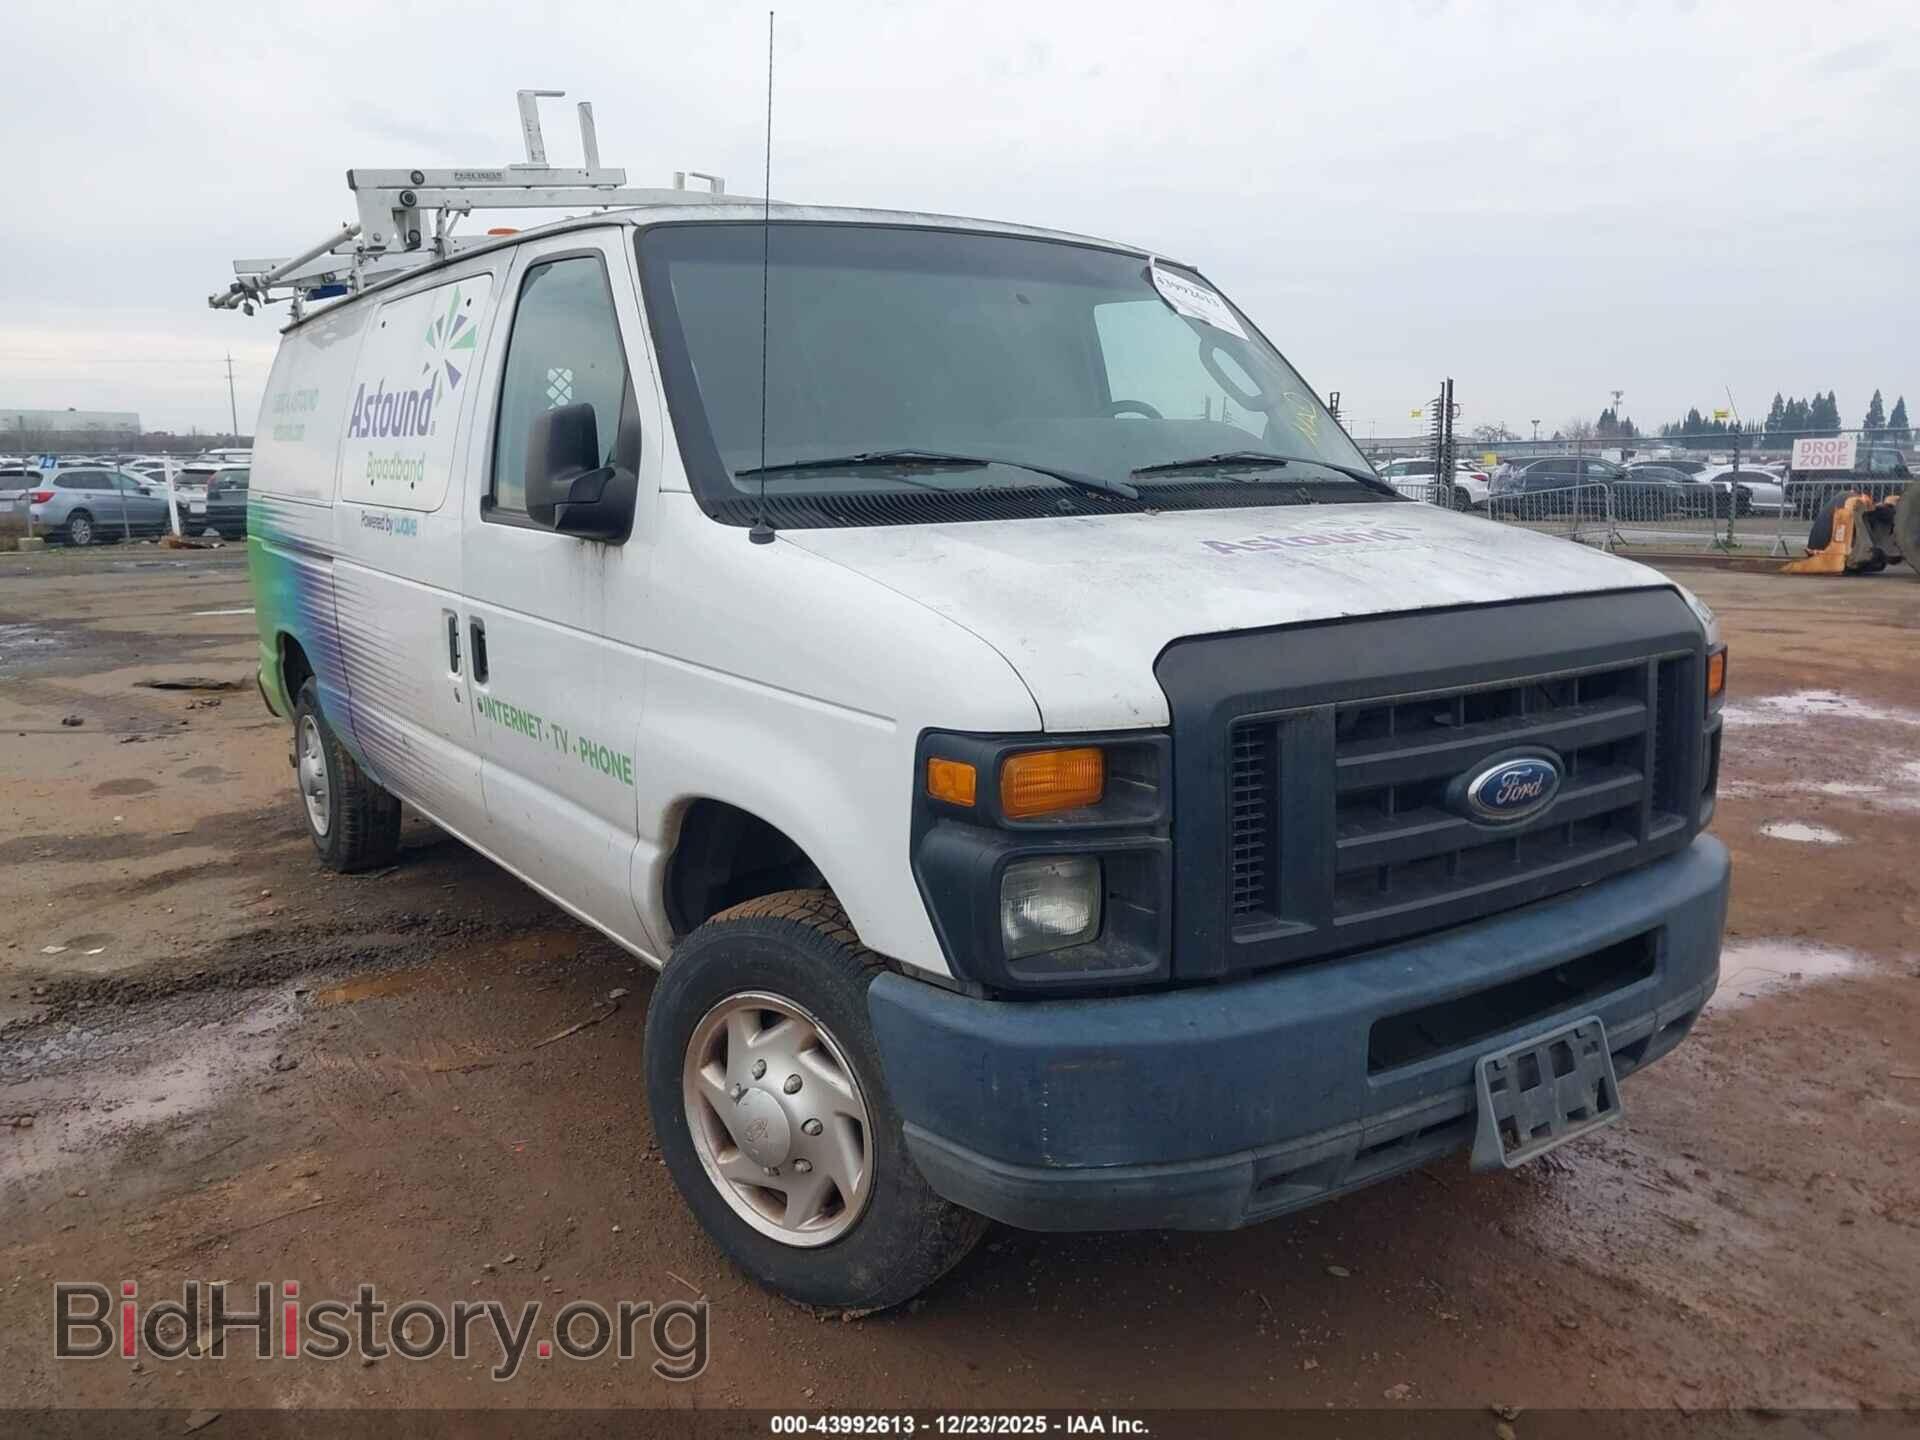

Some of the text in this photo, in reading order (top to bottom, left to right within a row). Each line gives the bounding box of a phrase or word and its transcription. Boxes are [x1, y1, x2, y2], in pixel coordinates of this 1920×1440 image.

[348, 370, 439, 438] Astound
[1801, 441, 1849, 454] DROP
[1801, 455, 1848, 467] ZONE
[366, 451, 425, 480] Broadband
[1200, 527, 1423, 554] Astound
[483, 696, 634, 785] INTERNET TV PHONE
[1496, 768, 1544, 804] Ford
